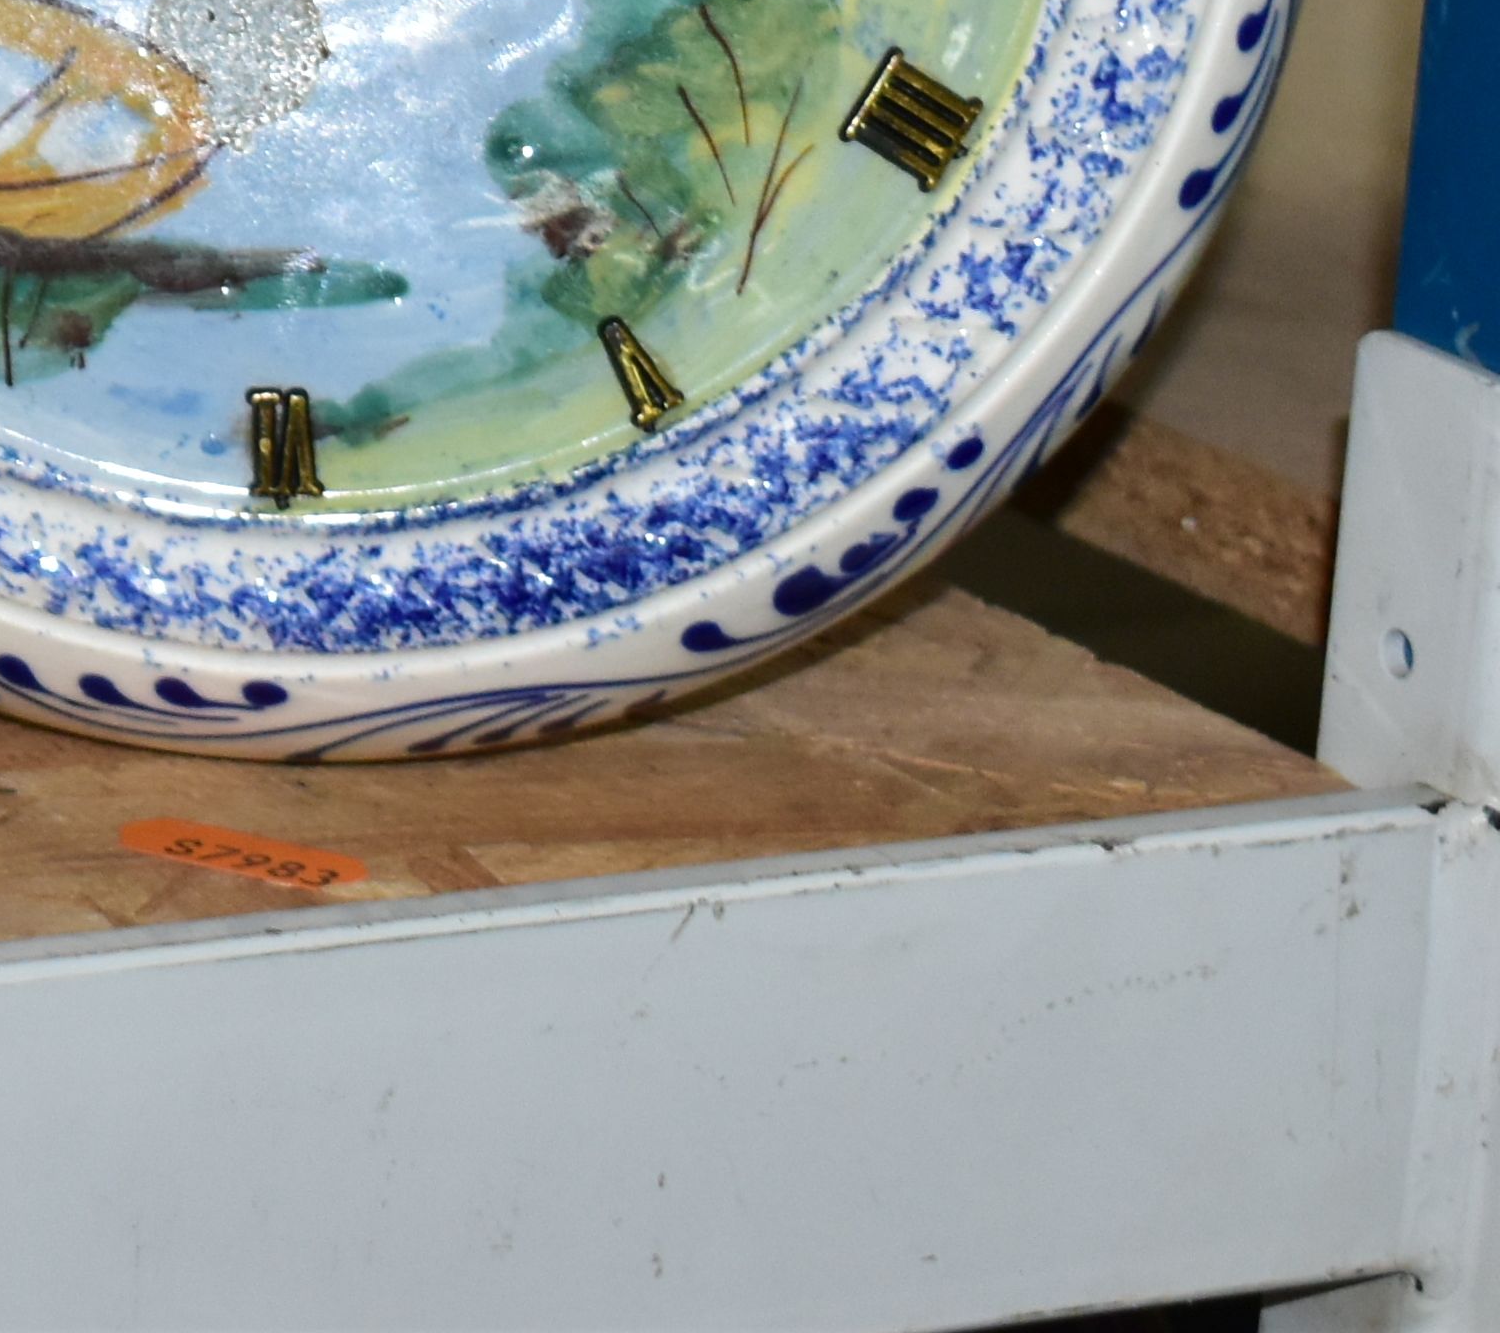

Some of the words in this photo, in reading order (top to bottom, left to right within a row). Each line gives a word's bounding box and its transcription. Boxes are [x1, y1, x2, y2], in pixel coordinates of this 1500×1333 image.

[839, 46, 984, 192] IIII
[598, 315, 684, 433] V
[245, 386, 326, 503] VI
